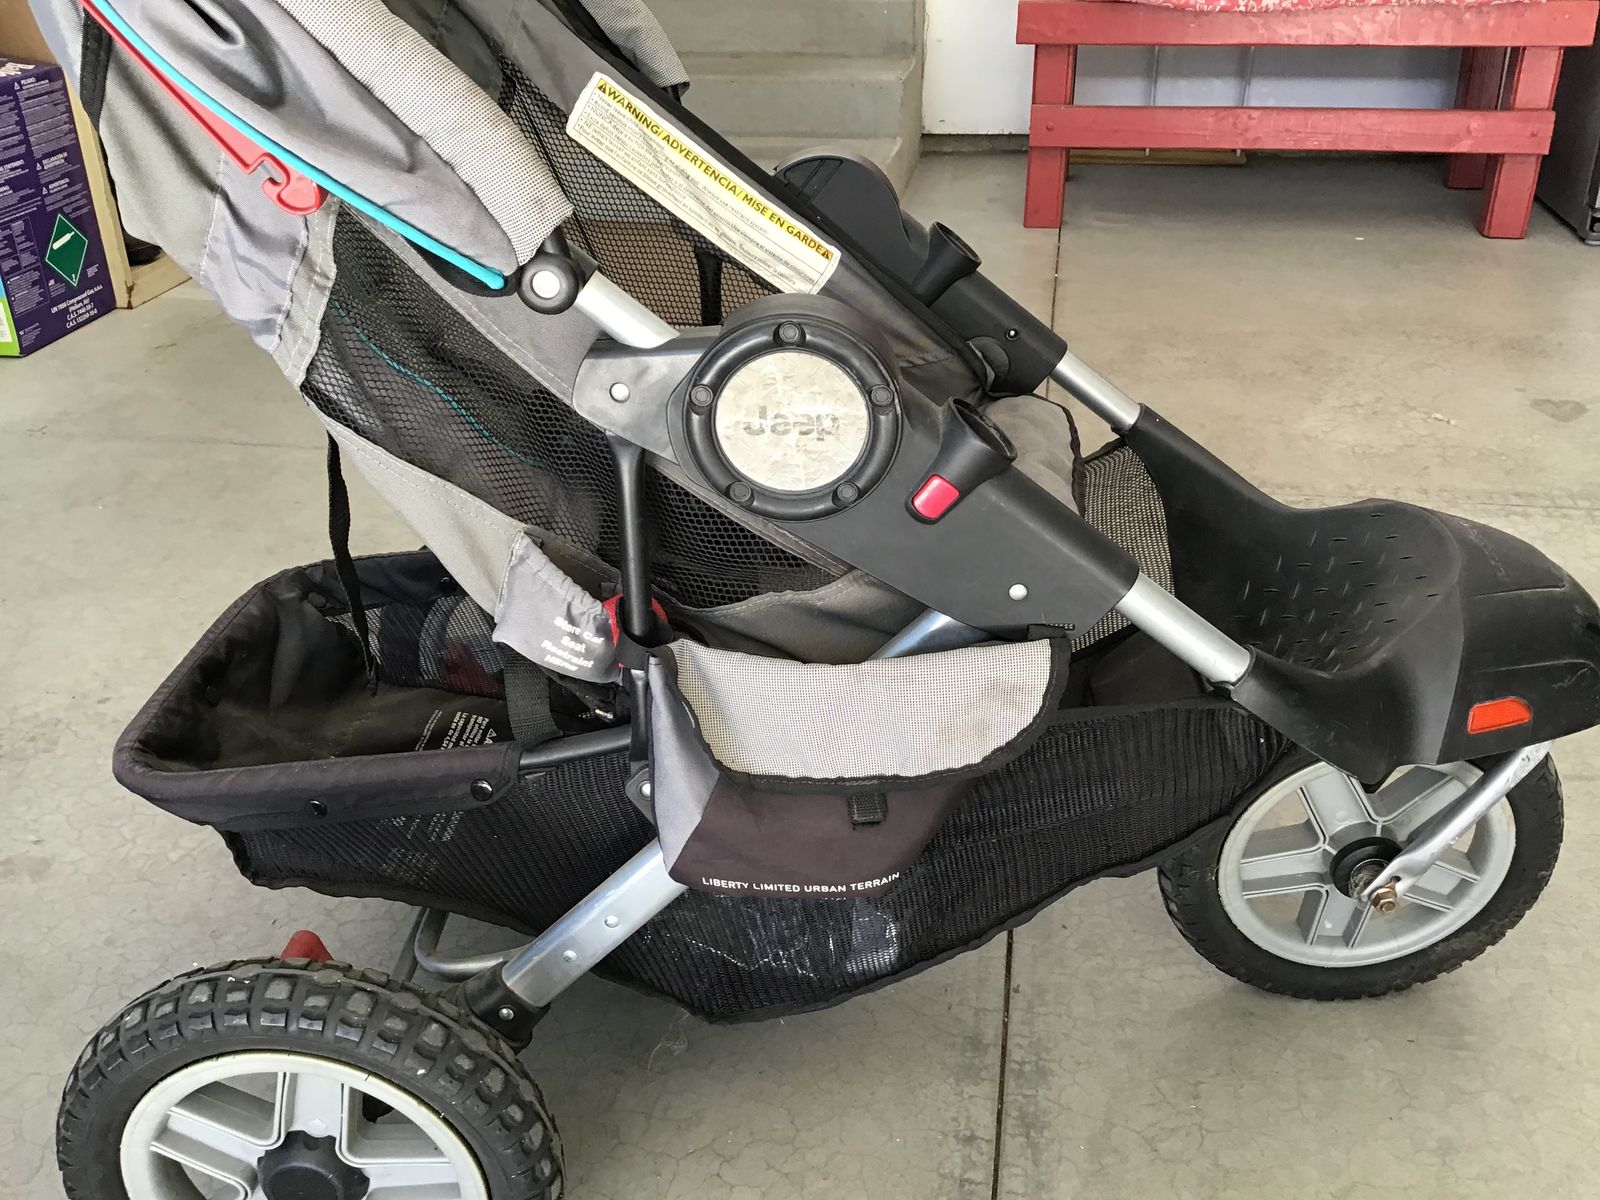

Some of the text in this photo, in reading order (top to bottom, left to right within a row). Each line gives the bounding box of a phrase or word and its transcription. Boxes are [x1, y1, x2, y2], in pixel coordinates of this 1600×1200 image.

[741, 193, 769, 216] MISE
[768, 212, 785, 228] EN
[785, 224, 823, 253] GARDE
[742, 405, 840, 441] Jeep
[553, 616, 604, 644] Store Car
[561, 636, 585, 653] Seat
[702, 871, 900, 893] LIBERTY LIMITED URBAN TERRAIN
